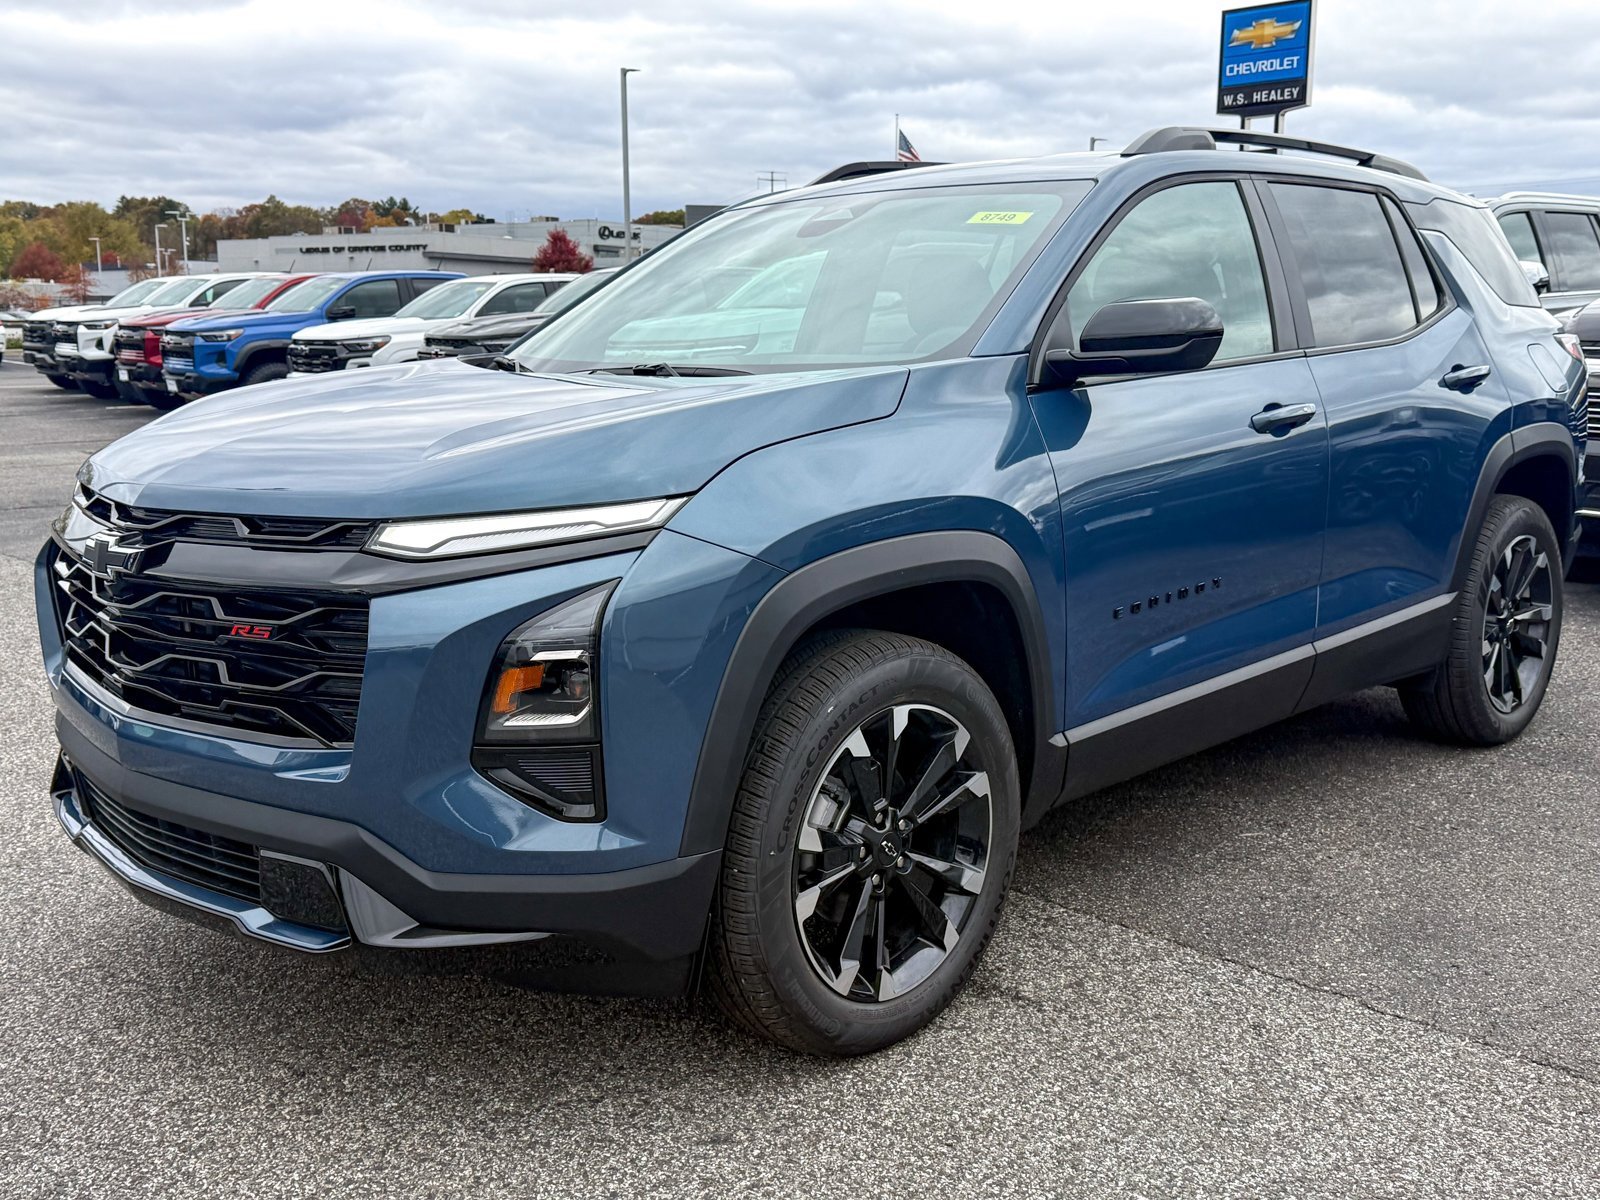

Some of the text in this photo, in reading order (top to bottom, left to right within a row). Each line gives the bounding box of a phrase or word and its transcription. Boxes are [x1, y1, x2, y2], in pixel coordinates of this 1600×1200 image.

[1225, 56, 1300, 77] CHEVROLET
[1223, 86, 1300, 106] W.S. HEALEY
[980, 213, 1017, 222] 8749
[388, 244, 428, 252] COUNTY
[230, 624, 273, 639] RS
